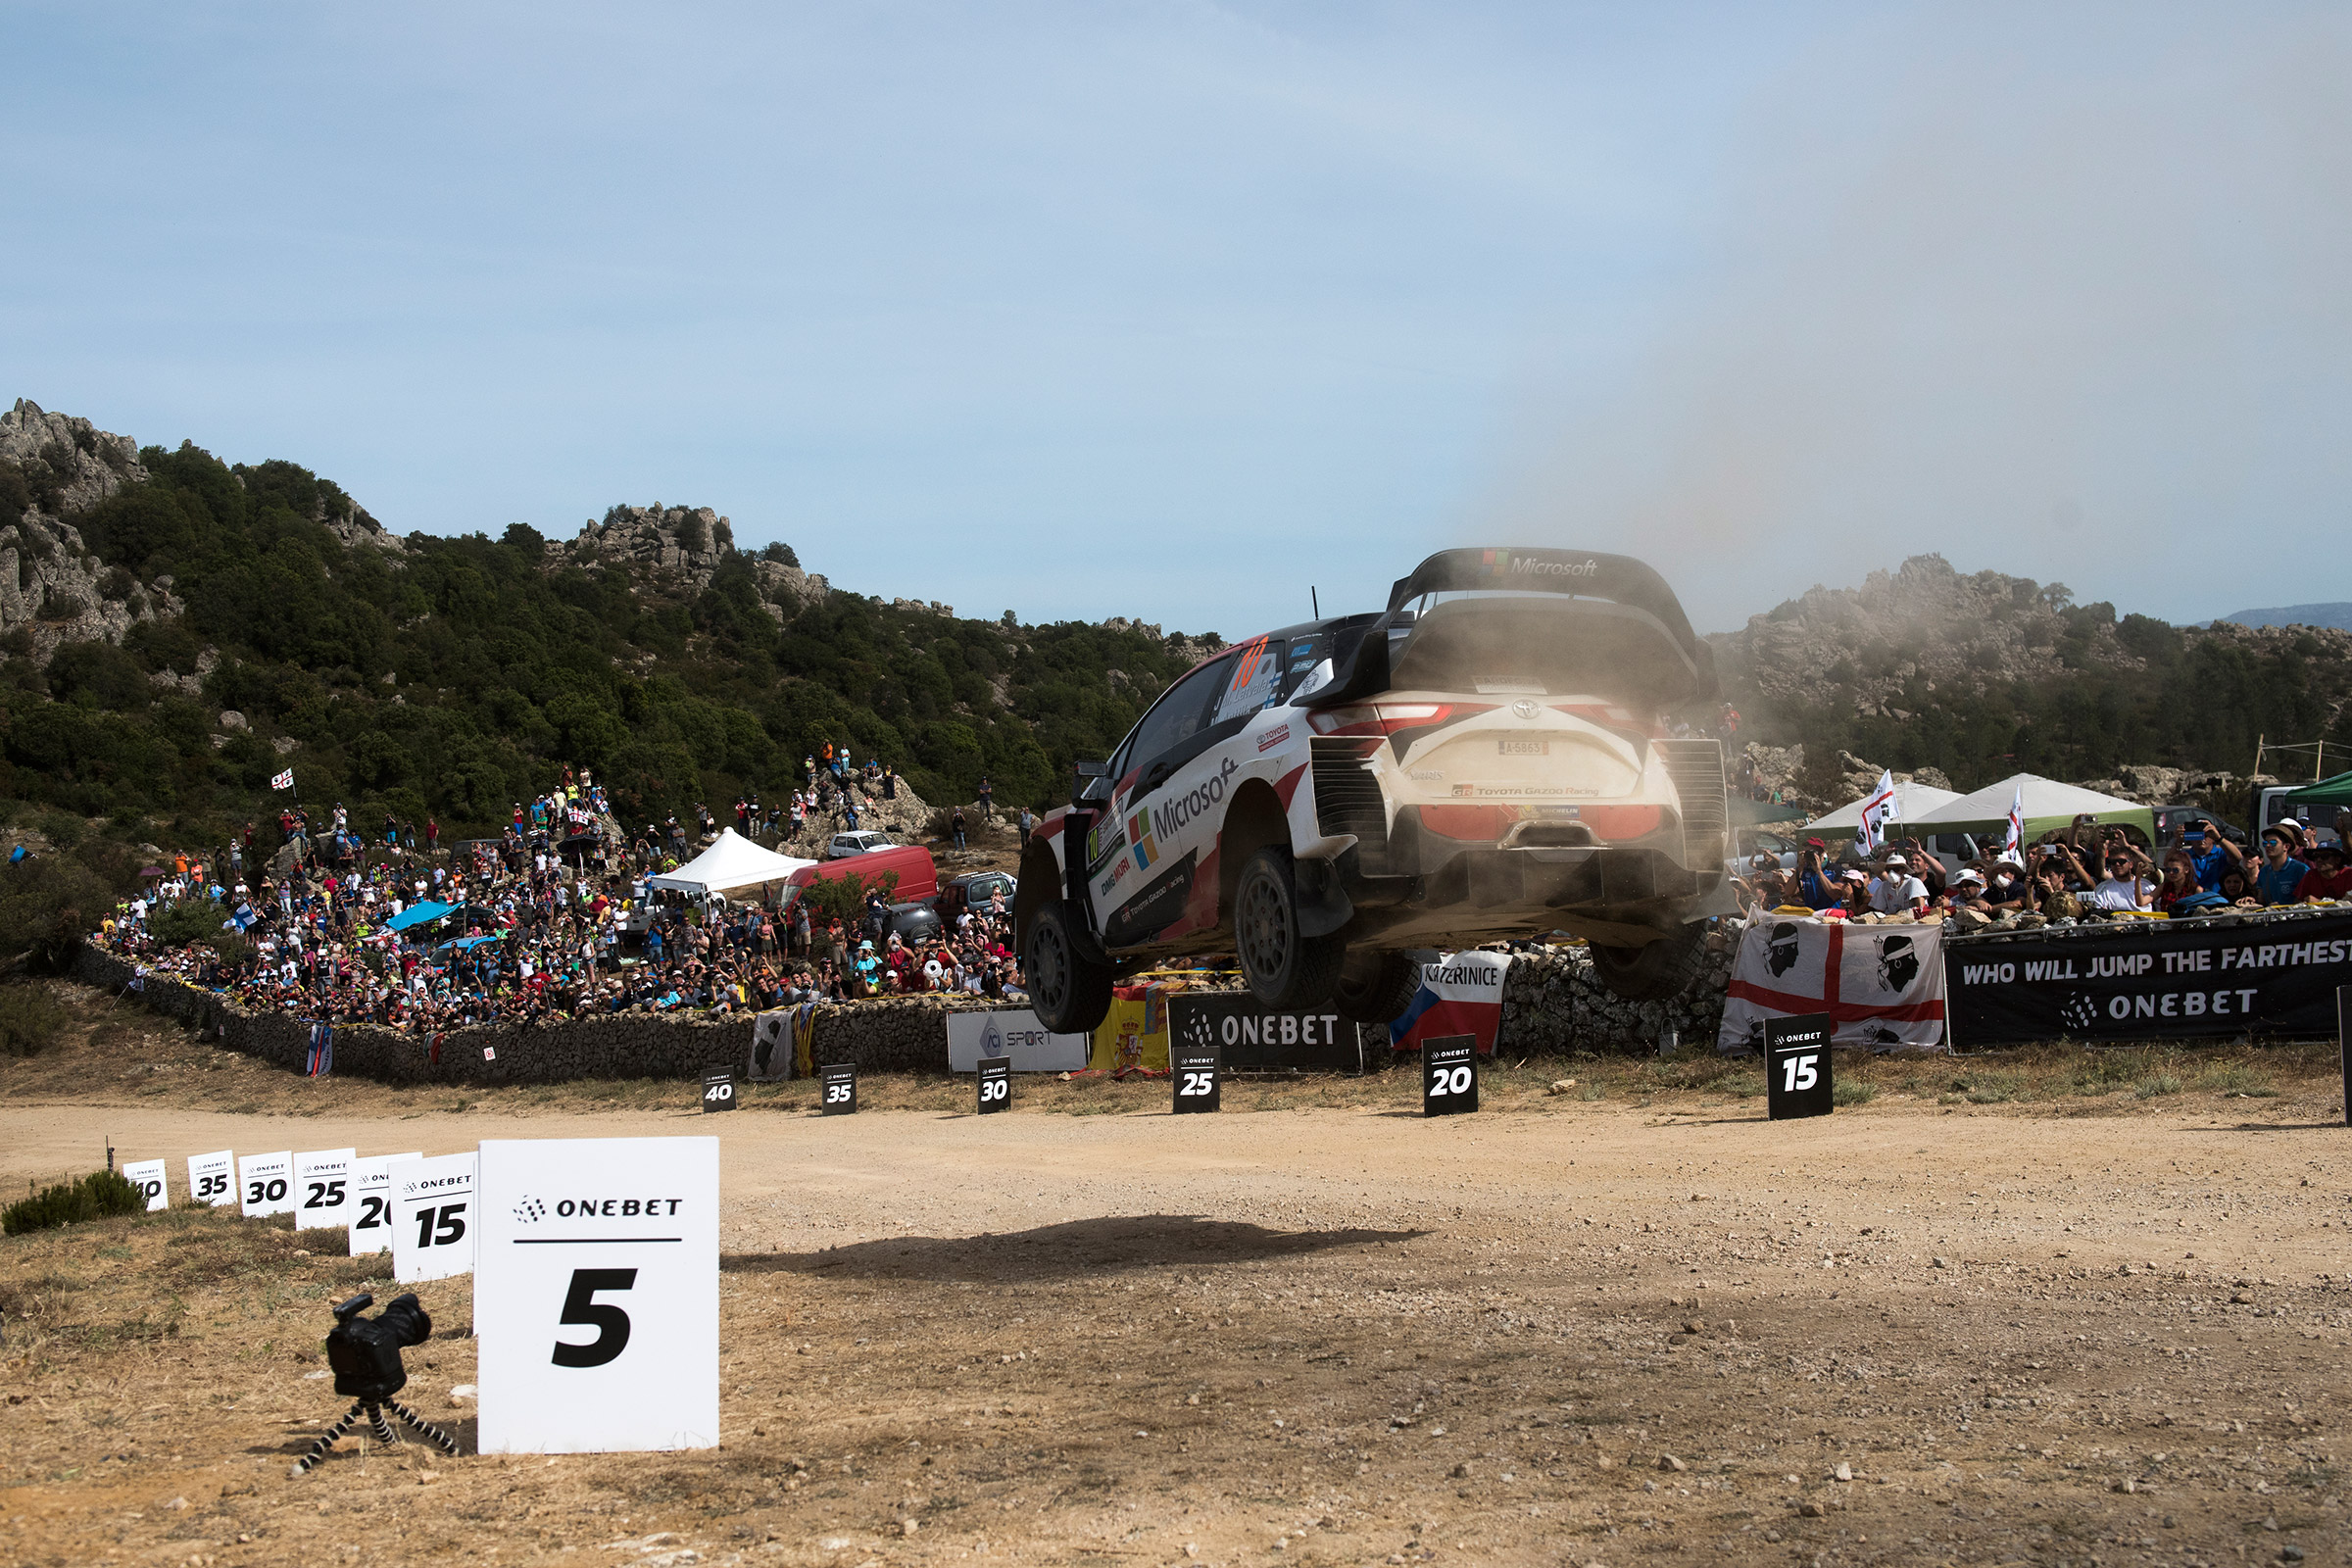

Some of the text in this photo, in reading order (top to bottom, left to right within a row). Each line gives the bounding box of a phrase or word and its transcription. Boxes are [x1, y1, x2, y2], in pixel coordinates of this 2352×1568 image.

[1511, 558, 1598, 576] Microsoft
[1232, 636, 1269, 691] 10
[1264, 723, 1290, 740] TOYOTA
[1506, 742, 1541, 754] A-5863
[1153, 757, 1239, 843] Microsoft
[1525, 787, 1563, 796] GAZOO
[1565, 787, 1599, 797] Racing
[1089, 828, 1099, 861] 10
[1102, 877, 1116, 897] DMG
[1113, 857, 1131, 882] MORI
[1130, 899, 1150, 916] TOYOTA
[1149, 886, 1167, 904] GAZOO
[1425, 963, 1498, 986] KATEŘINICE
[1963, 962, 2016, 986] WHO
[2025, 958, 2079, 982] WILL
[2085, 954, 2153, 979] JUMP
[2161, 950, 2212, 973] THE
[2109, 989, 2258, 1020] ONEBET
[1006, 1031, 1052, 1047] SPORT
[1221, 1014, 1339, 1046] ONEBET
[1787, 1031, 1822, 1043] ONEBET
[1441, 1049, 1470, 1057] ONEBET
[1179, 1072, 1214, 1097] 25
[1429, 1066, 1472, 1097] 20
[1783, 1054, 1819, 1093] 15
[705, 1084, 733, 1102] 40
[826, 1084, 852, 1103] 35
[980, 1079, 1008, 1102] 30
[256, 1163, 285, 1172] ONEBET
[314, 1162, 347, 1171] ONEBET
[197, 1174, 227, 1198] 35
[246, 1178, 287, 1204] 30
[420, 1174, 472, 1190] ONEBET
[304, 1180, 347, 1209] 25
[557, 1199, 683, 1217] ONEBET
[416, 1202, 467, 1249] 15
[551, 1268, 639, 1368] 5
